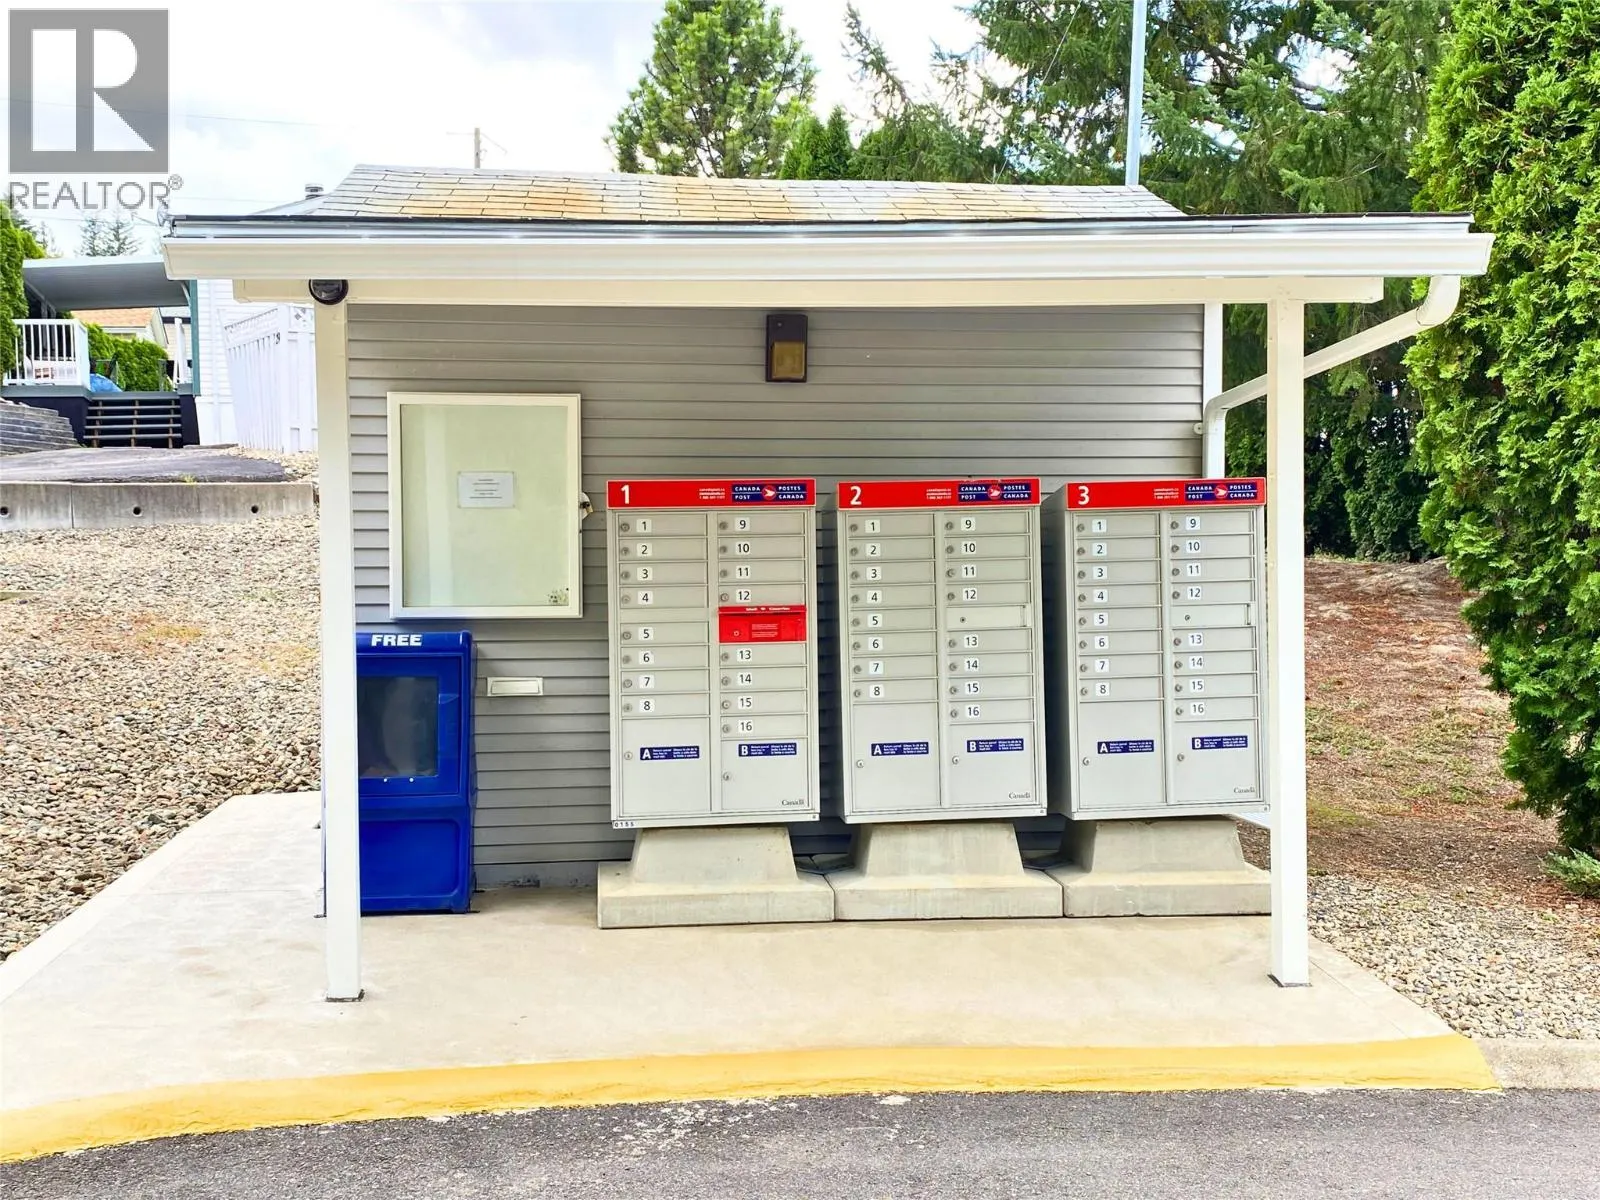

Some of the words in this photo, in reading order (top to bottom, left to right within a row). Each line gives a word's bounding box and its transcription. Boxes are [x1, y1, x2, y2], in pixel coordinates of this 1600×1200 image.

[621, 485, 629, 504] 1
[850, 486, 862, 505] 2
[1078, 486, 1089, 505] 3
[642, 521, 647, 531] 1
[739, 519, 747, 530] 9
[871, 521, 875, 532] 1
[965, 519, 972, 529] 9
[1097, 521, 1102, 531] 1
[1189, 518, 1197, 529] 9
[641, 544, 648, 555] 2
[737, 543, 750, 553] 10
[870, 545, 877, 555] 2
[963, 542, 976, 553] 10
[1096, 544, 1103, 555] 2
[1188, 541, 1200, 552] 10
[642, 568, 649, 579] 3
[738, 567, 749, 577] 11
[871, 568, 878, 579] 3
[964, 566, 975, 576] 11
[1097, 567, 1104, 578] 3
[1189, 565, 1199, 575] 11
[642, 592, 649, 603] 4
[738, 590, 750, 601] 12
[871, 592, 878, 602] 4
[964, 589, 977, 600] 12
[1097, 591, 1104, 601] 4
[1189, 587, 1201, 598] 12
[872, 615, 879, 626] 5
[1098, 614, 1105, 625] 5
[643, 628, 650, 639] 5
[1190, 633, 1203, 644] 13
[371, 634, 423, 646] FREE
[872, 638, 880, 649] 6
[966, 636, 978, 646] 13
[1098, 637, 1106, 648] 6
[643, 652, 650, 663] 6
[739, 649, 752, 660] 13
[873, 662, 880, 672] 7
[966, 660, 978, 670] 14
[1099, 660, 1106, 670] 7
[1191, 657, 1203, 667] 14
[644, 676, 651, 687] 7
[739, 673, 752, 684] 14
[967, 682, 979, 693] 15
[1099, 684, 1107, 695] 8
[1191, 680, 1204, 690] 15
[873, 686, 881, 696] 8
[643, 700, 651, 711] 8
[740, 697, 752, 708] 15
[967, 706, 980, 716] 16
[1192, 703, 1205, 714] 16
[740, 721, 753, 732] 16
[969, 741, 977, 752] B
[1099, 742, 1109, 753] A
[1194, 738, 1202, 749] B
[642, 748, 652, 760] A
[741, 745, 749, 756] B
[873, 744, 882, 755] A
